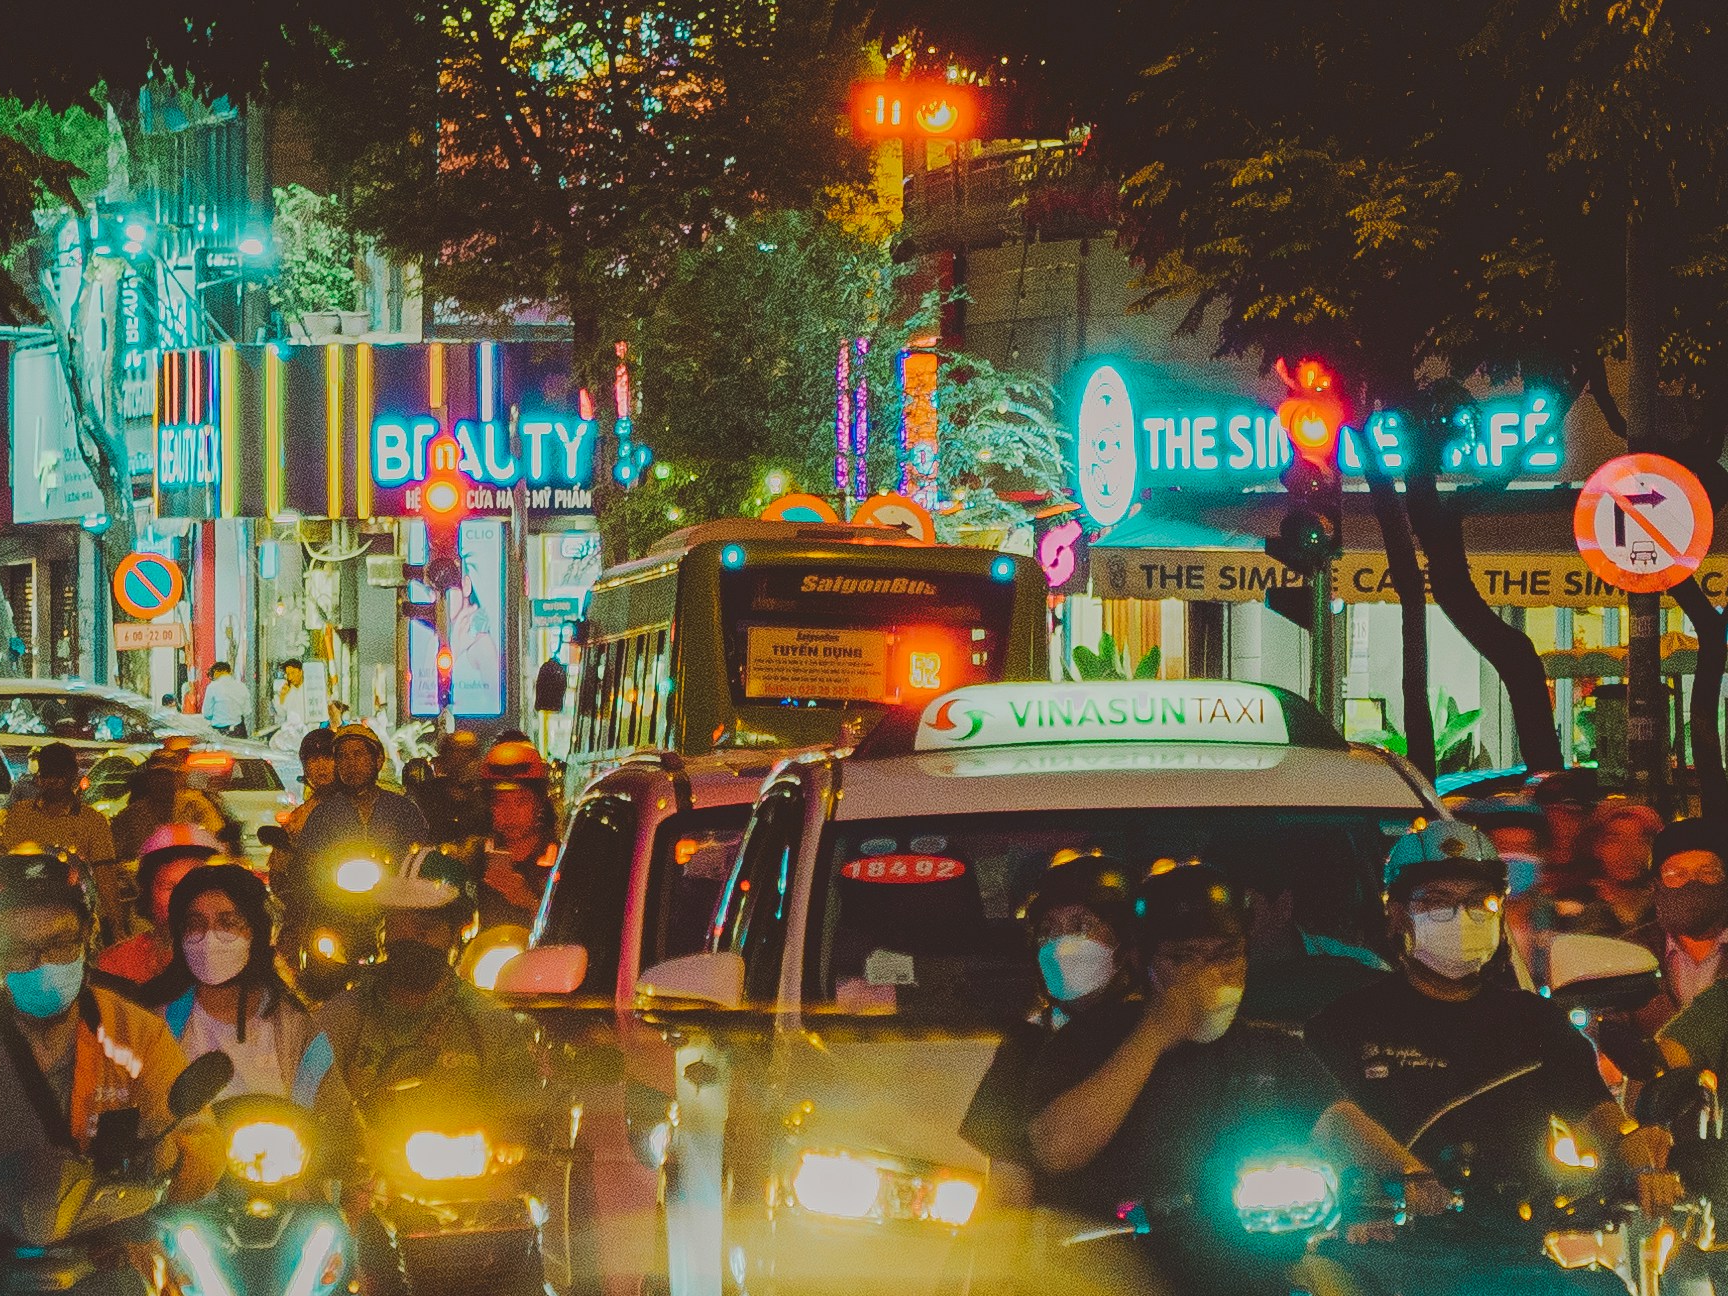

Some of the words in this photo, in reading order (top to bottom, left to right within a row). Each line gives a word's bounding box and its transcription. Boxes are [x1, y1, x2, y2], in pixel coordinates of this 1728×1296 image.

[1143, 417, 1219, 470] THE
[1229, 414, 1404, 469] SIMLE
[1450, 397, 1559, 467] AFÉ
[161, 428, 197, 484] BEAUTY
[496, 486, 530, 509] HÀG
[465, 529, 494, 540] CLIO
[801, 574, 937, 596] SaigonBus
[1140, 563, 1205, 591] THE
[1218, 566, 1339, 592] SIMP
[1352, 563, 1431, 593] CA
[1484, 570, 1550, 596] THE
[908, 651, 942, 690] 52
